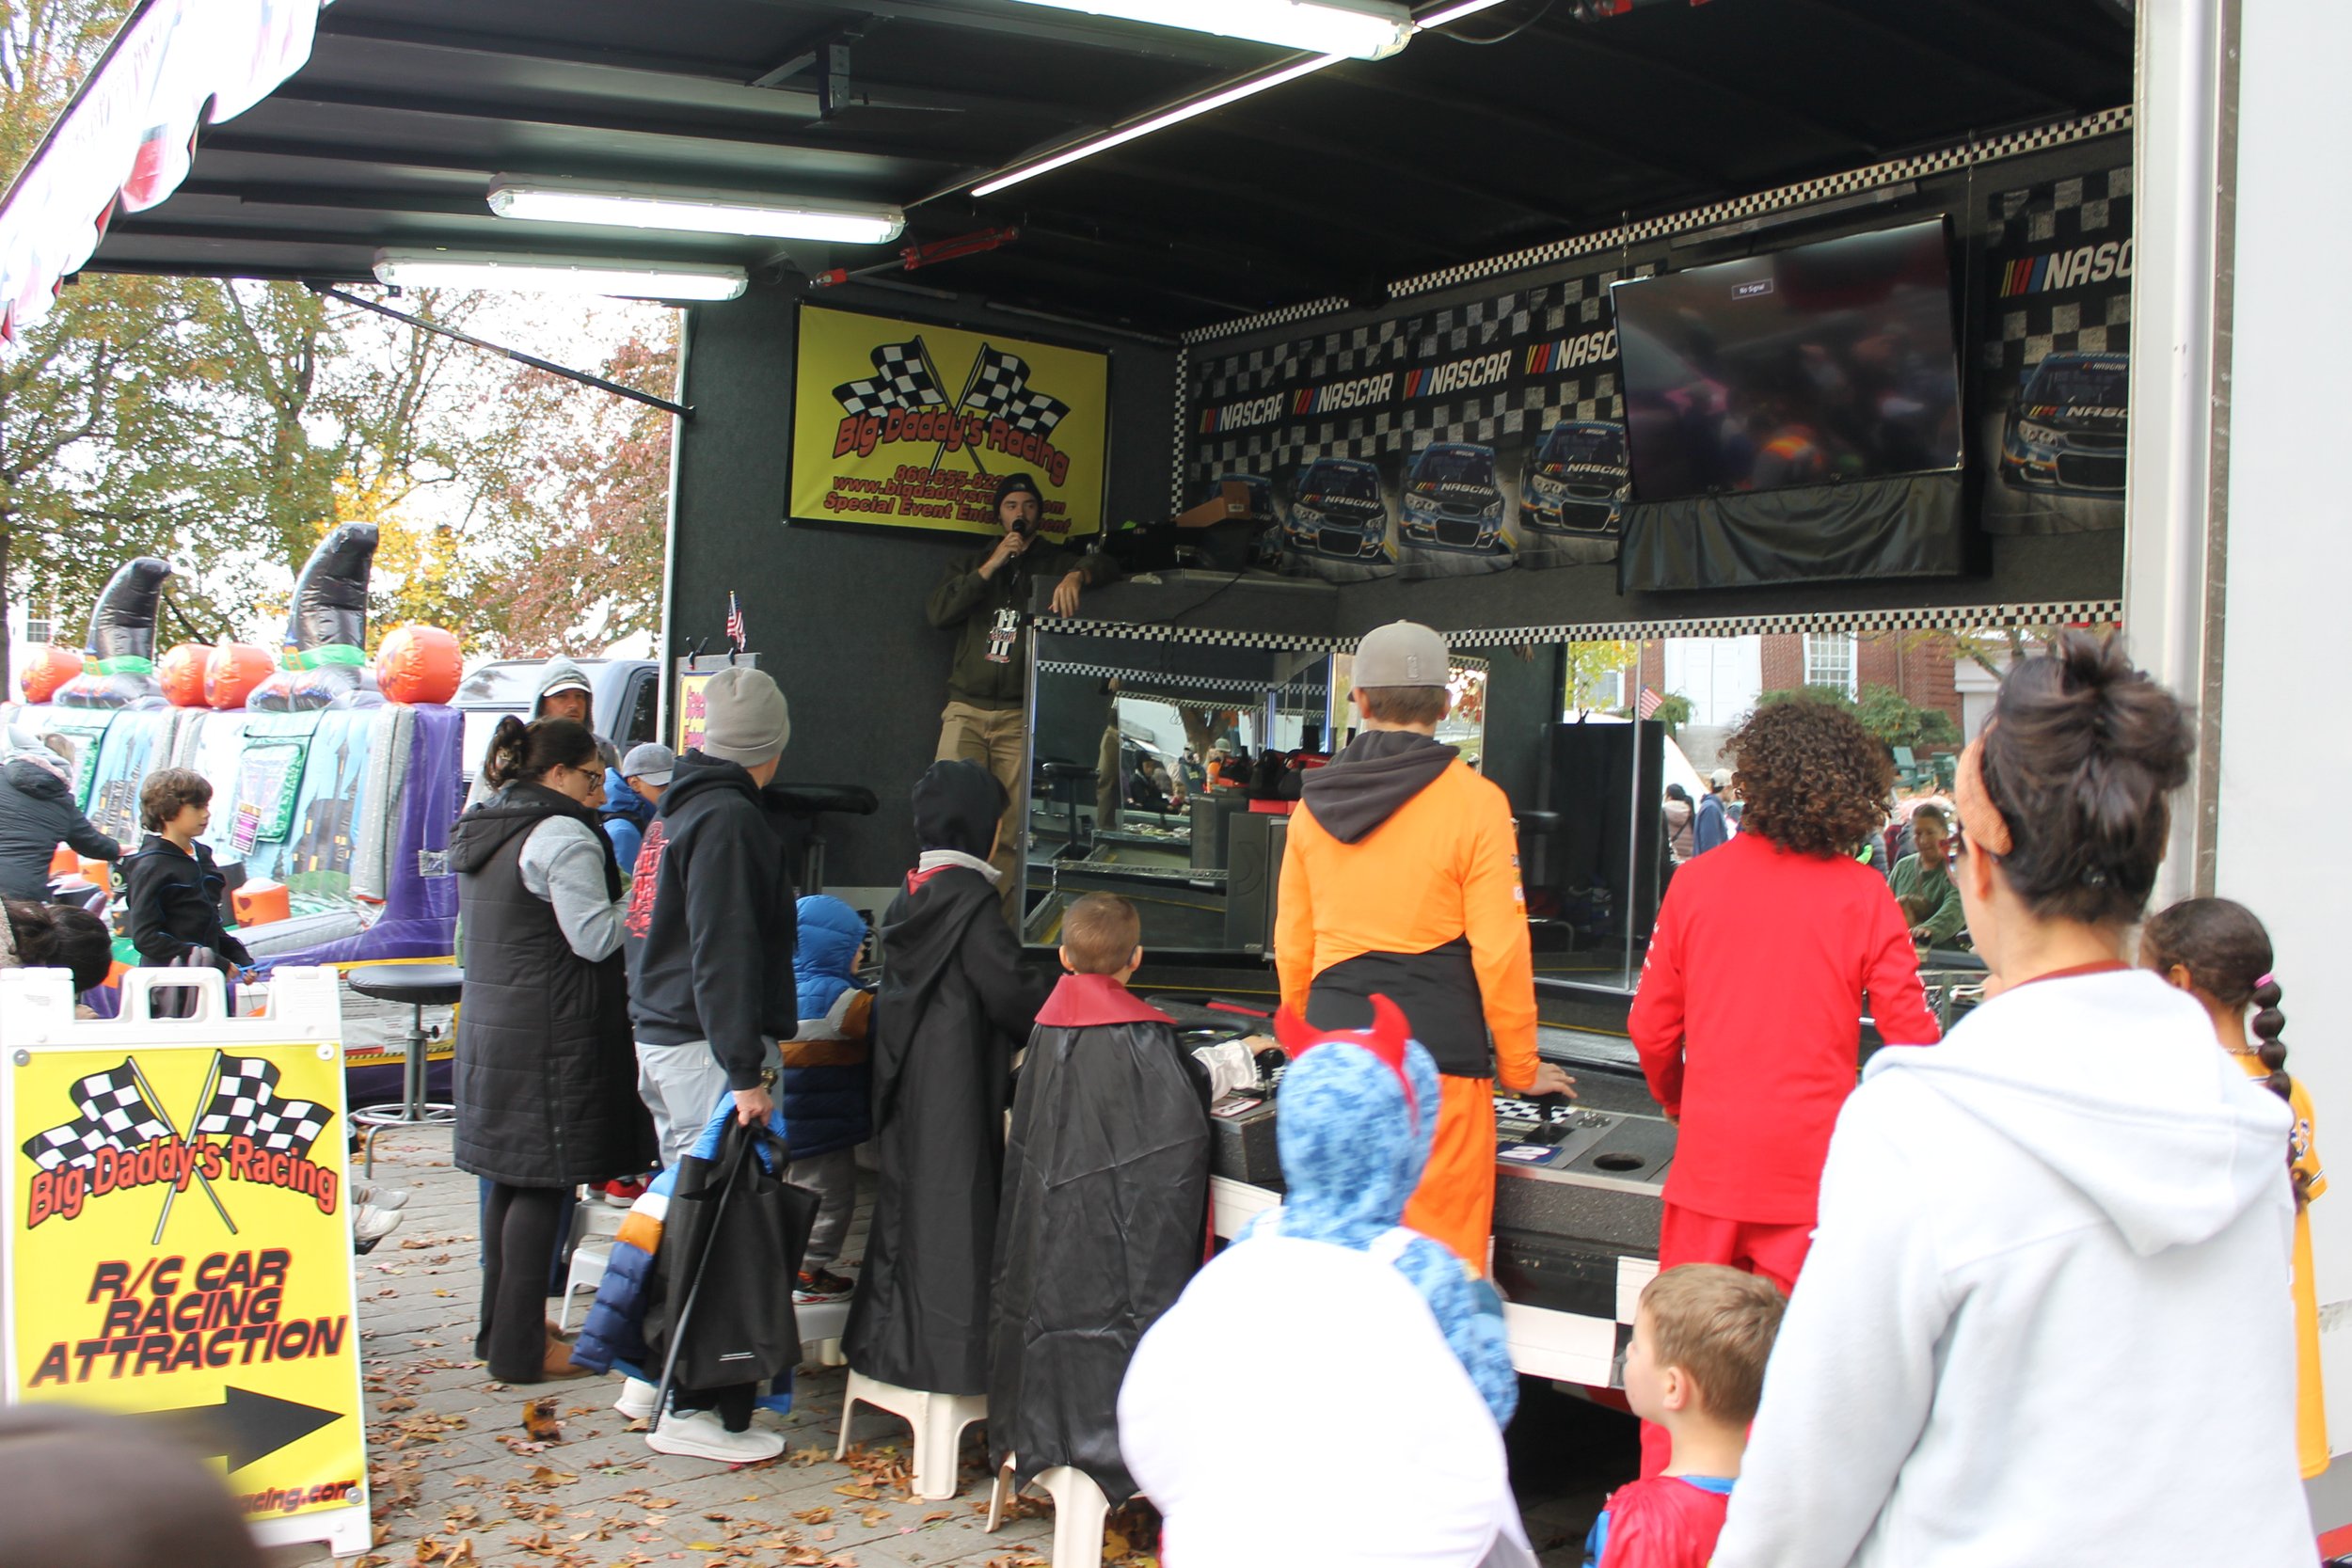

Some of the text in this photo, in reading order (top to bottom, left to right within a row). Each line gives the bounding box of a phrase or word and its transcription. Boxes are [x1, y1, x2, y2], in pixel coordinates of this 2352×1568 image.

[2042, 238, 2132, 292] NASC
[1427, 349, 1512, 395] NASCAR
[1555, 329, 1617, 371] NASC
[1219, 392, 1284, 431] NASCAR
[1317, 372, 1394, 413] NASCAR
[2066, 405, 2128, 418] NASC
[833, 405, 1070, 487] Big Daddy's Racing
[895, 465, 1003, 490] 860-655-822
[824, 492, 894, 515] Special
[898, 499, 952, 518] Event
[27, 1132, 338, 1229] Big Daddy's Racing
[87, 1248, 292, 1304] R/C CAR
[101, 1285, 283, 1339] RACING
[27, 1315, 348, 1388] ATTRACTION
